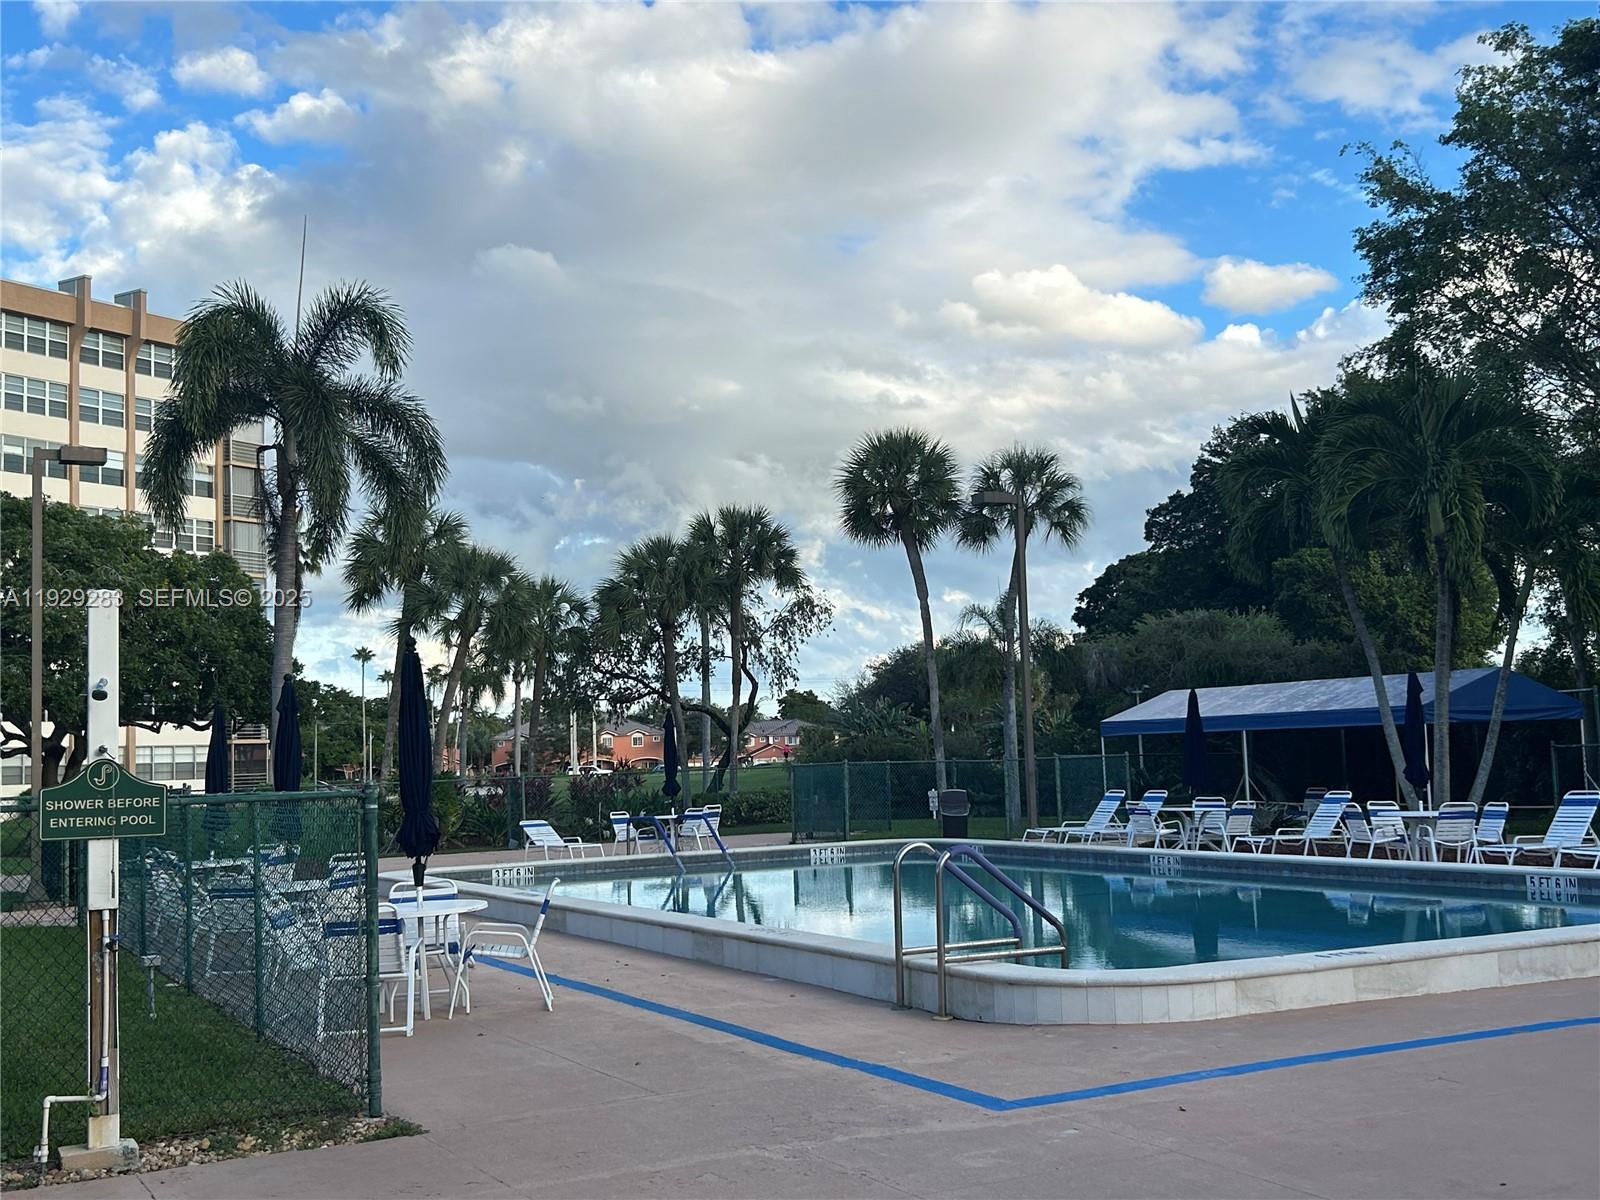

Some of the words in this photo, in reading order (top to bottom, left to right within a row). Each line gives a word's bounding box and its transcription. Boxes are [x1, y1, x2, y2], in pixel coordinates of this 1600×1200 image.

[45, 799, 104, 811] SHOWER
[107, 797, 160, 809] BEFORE
[50, 816, 117, 828] ENTERING
[120, 814, 157, 825] POOL
[502, 868, 513, 878] FT
[524, 867, 534, 877] IN
[1539, 876, 1551, 888] FT
[1565, 877, 1577, 888] IN
